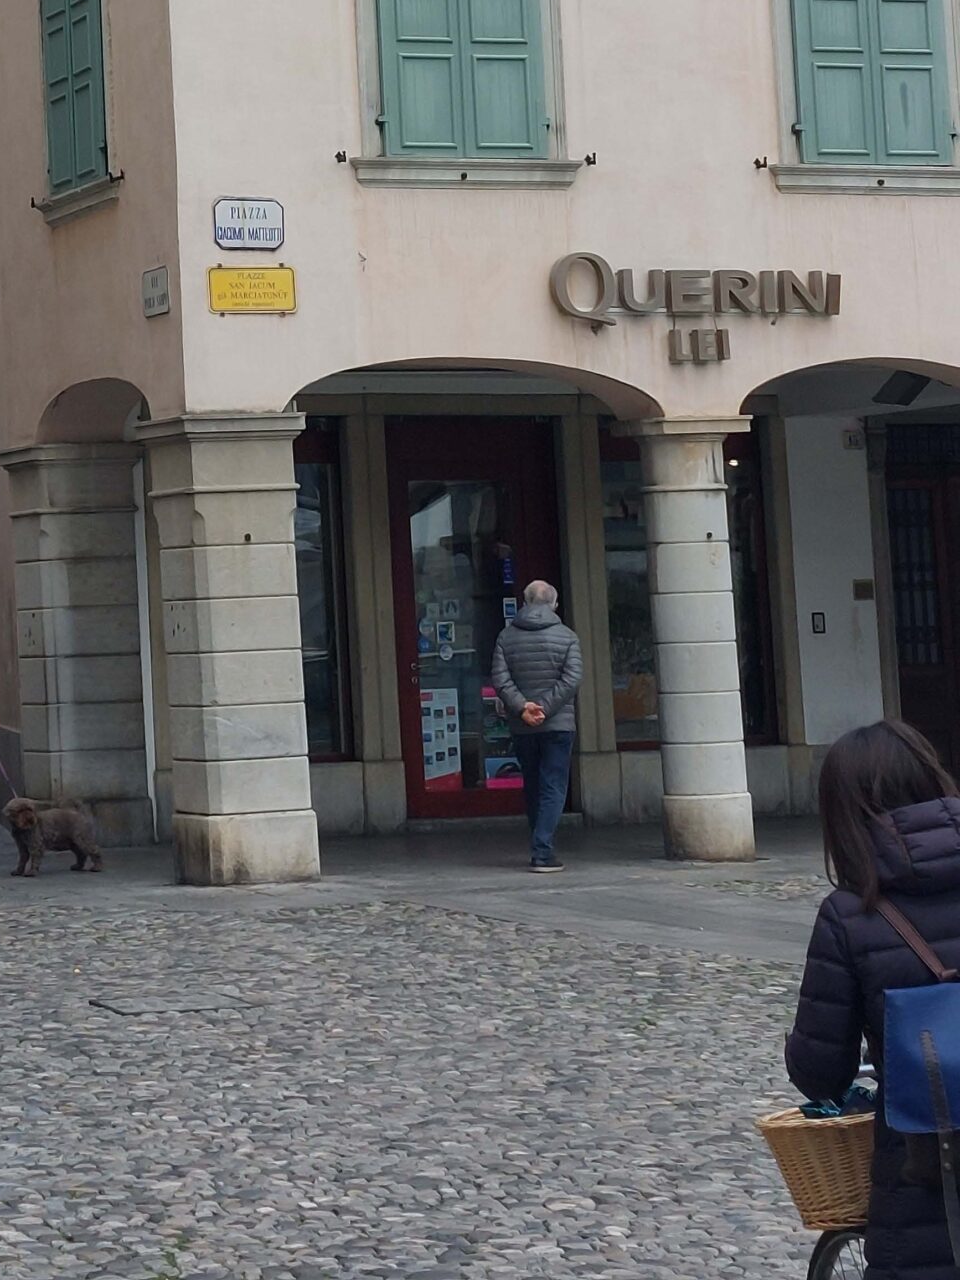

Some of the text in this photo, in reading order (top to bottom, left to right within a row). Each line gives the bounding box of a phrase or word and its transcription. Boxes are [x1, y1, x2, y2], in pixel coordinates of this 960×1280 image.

[230, 207, 267, 219] PIAZZA
[217, 226, 282, 241] GIACOMO MATTEOTTI
[550, 251, 841, 326] QUERINI
[668, 329, 731, 363] LEI
